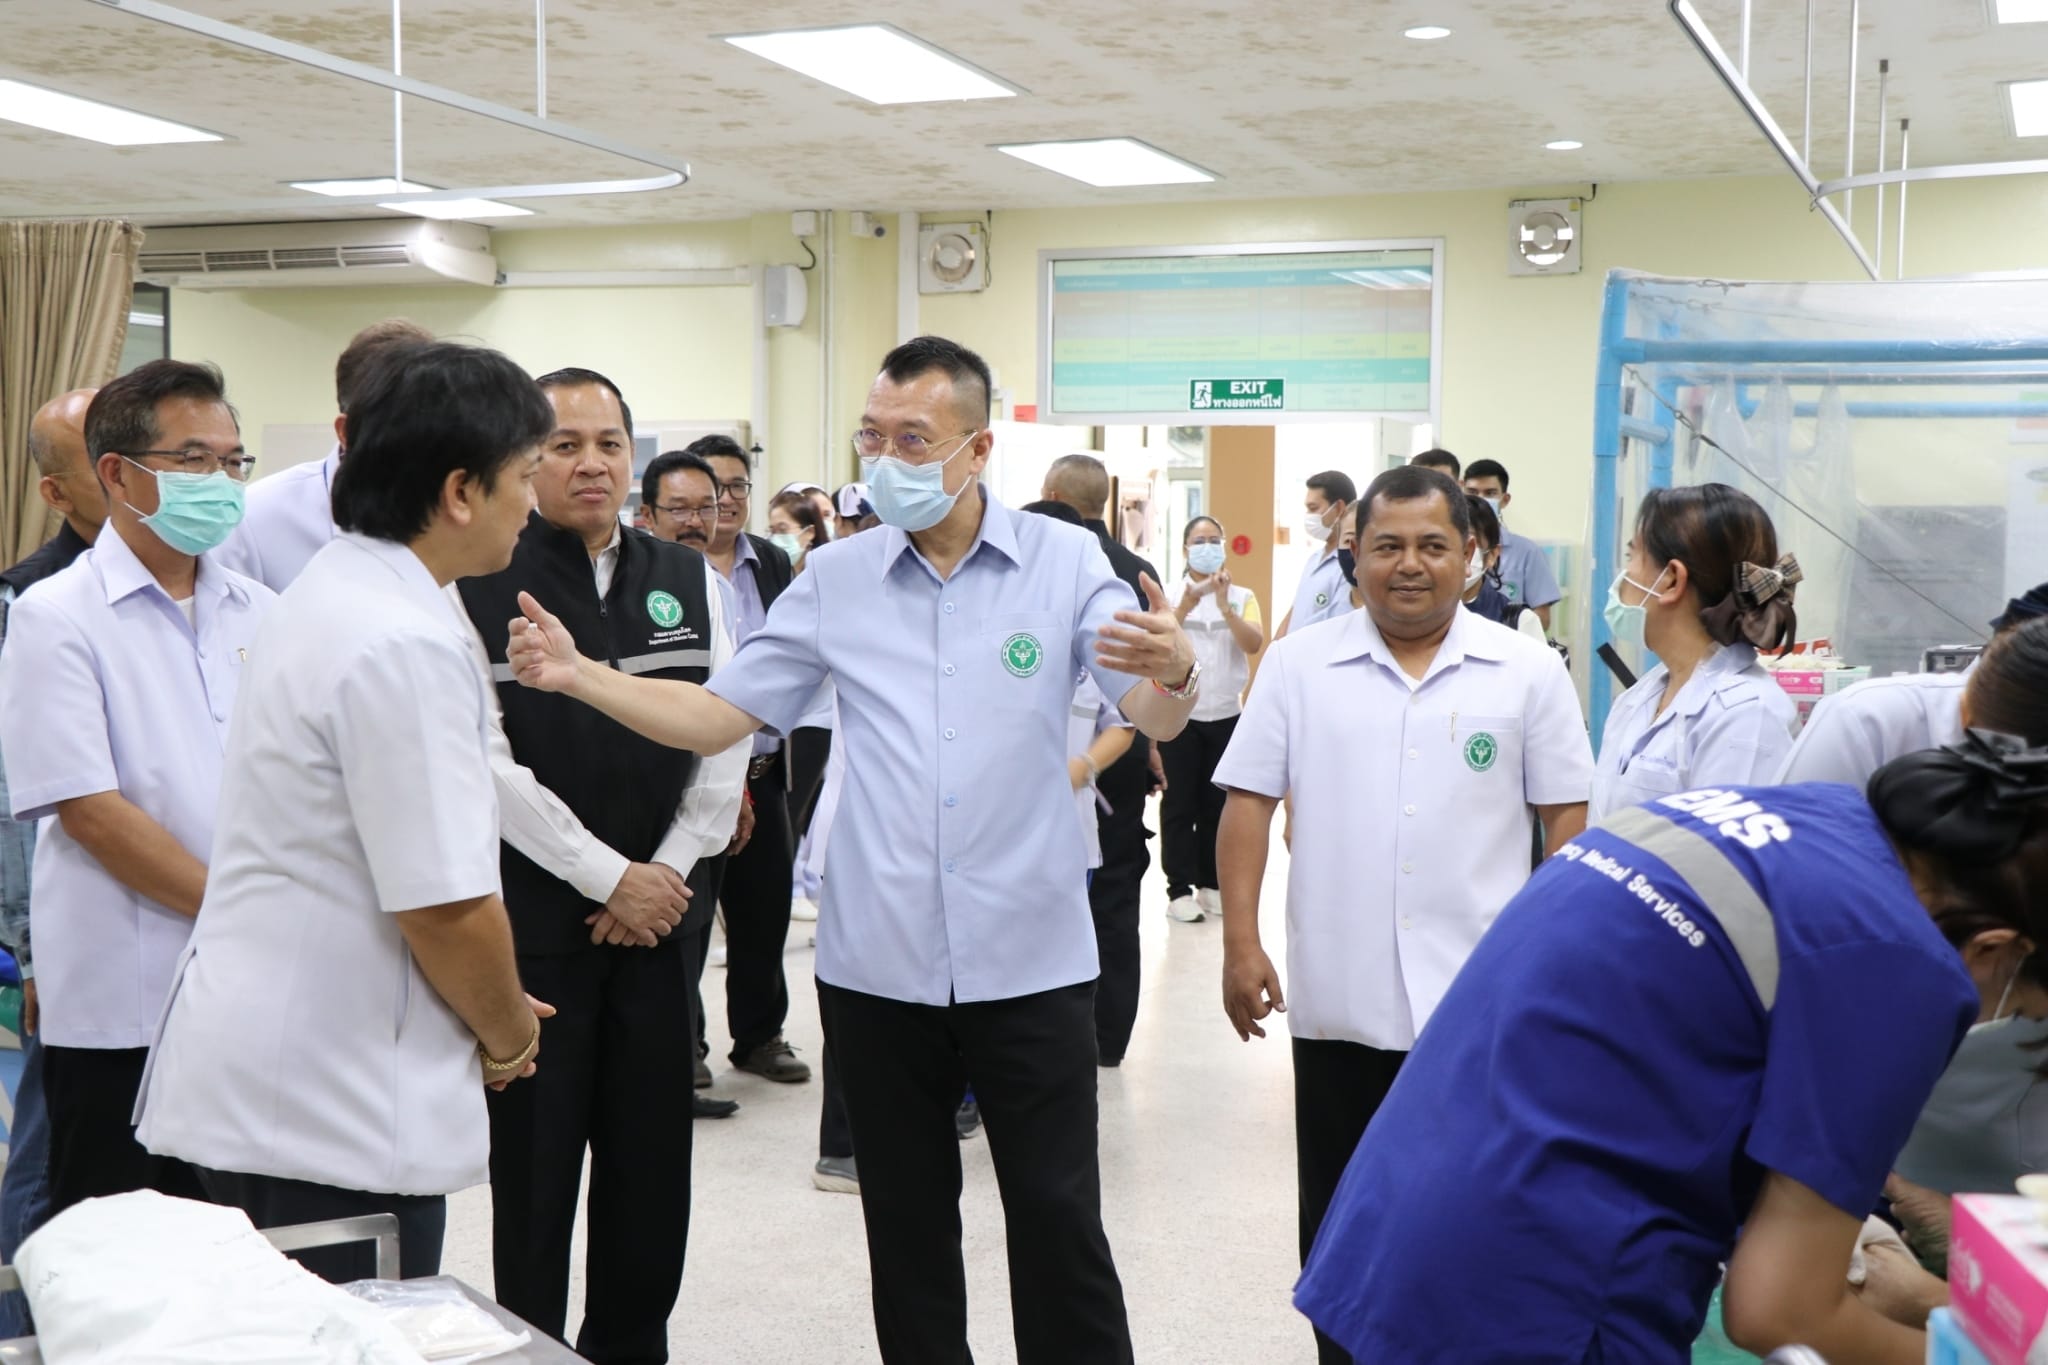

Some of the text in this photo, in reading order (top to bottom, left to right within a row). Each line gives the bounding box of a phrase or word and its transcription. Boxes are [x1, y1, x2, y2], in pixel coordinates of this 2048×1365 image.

[1213, 393, 1282, 408] ทางออกหนีไฟ
[1230, 381, 1267, 394] EXIT
[1655, 789, 1791, 849] EMS
[1627, 874, 1705, 948] Services
